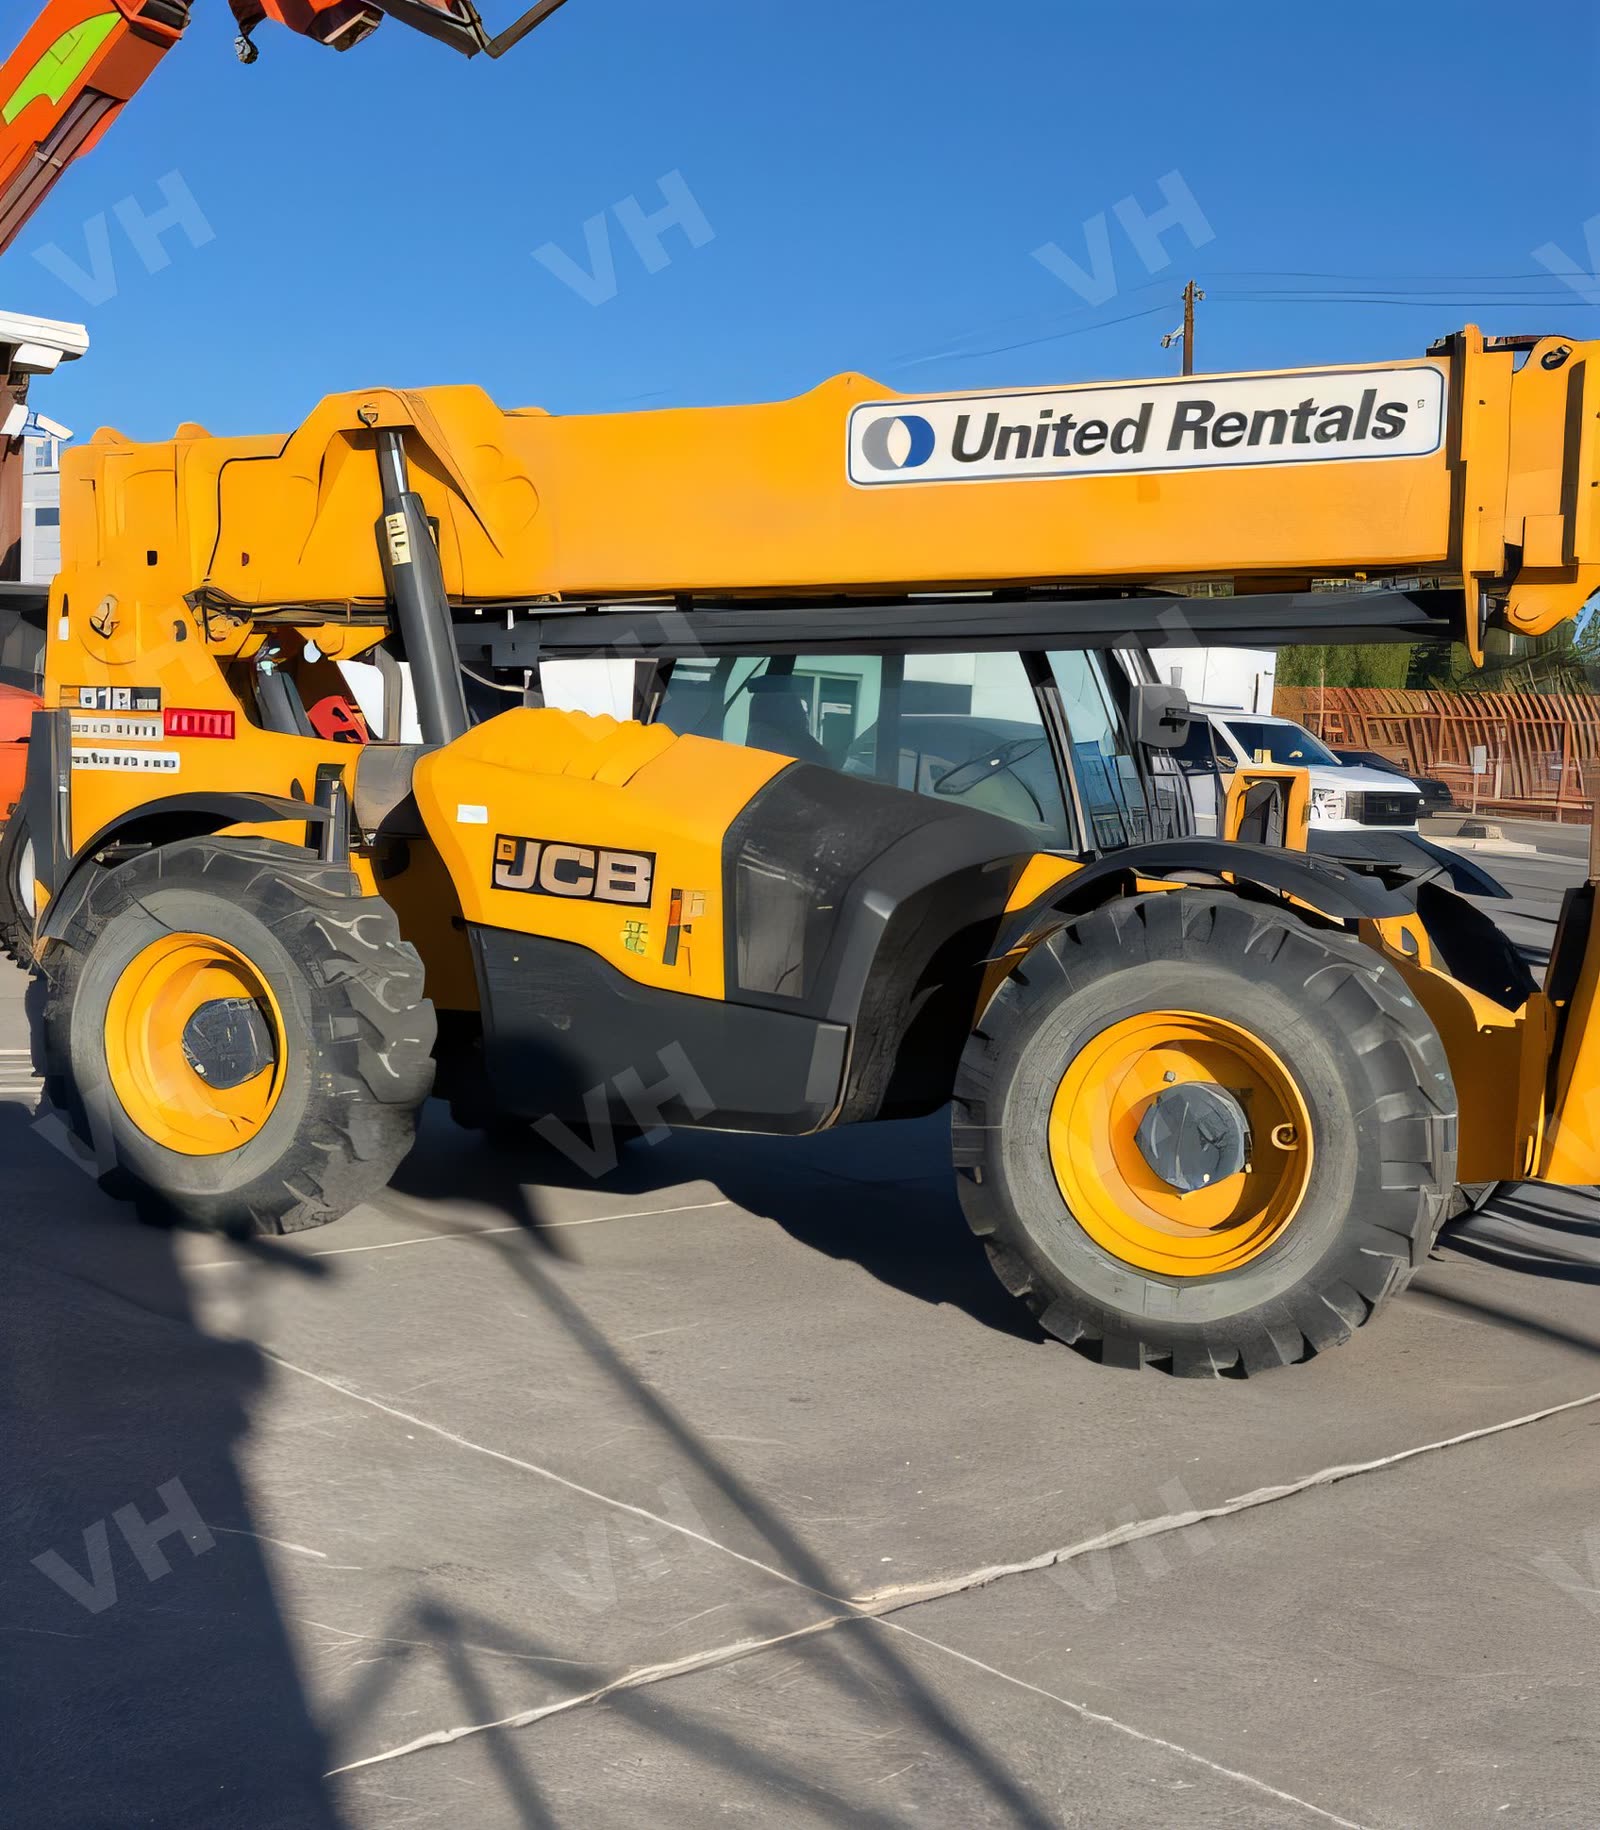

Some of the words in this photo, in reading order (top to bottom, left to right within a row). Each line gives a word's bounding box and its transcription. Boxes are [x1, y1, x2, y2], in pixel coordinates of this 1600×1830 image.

[951, 403, 1154, 463] United
[1167, 389, 1408, 451] Rentals
[495, 840, 652, 903] JCB
